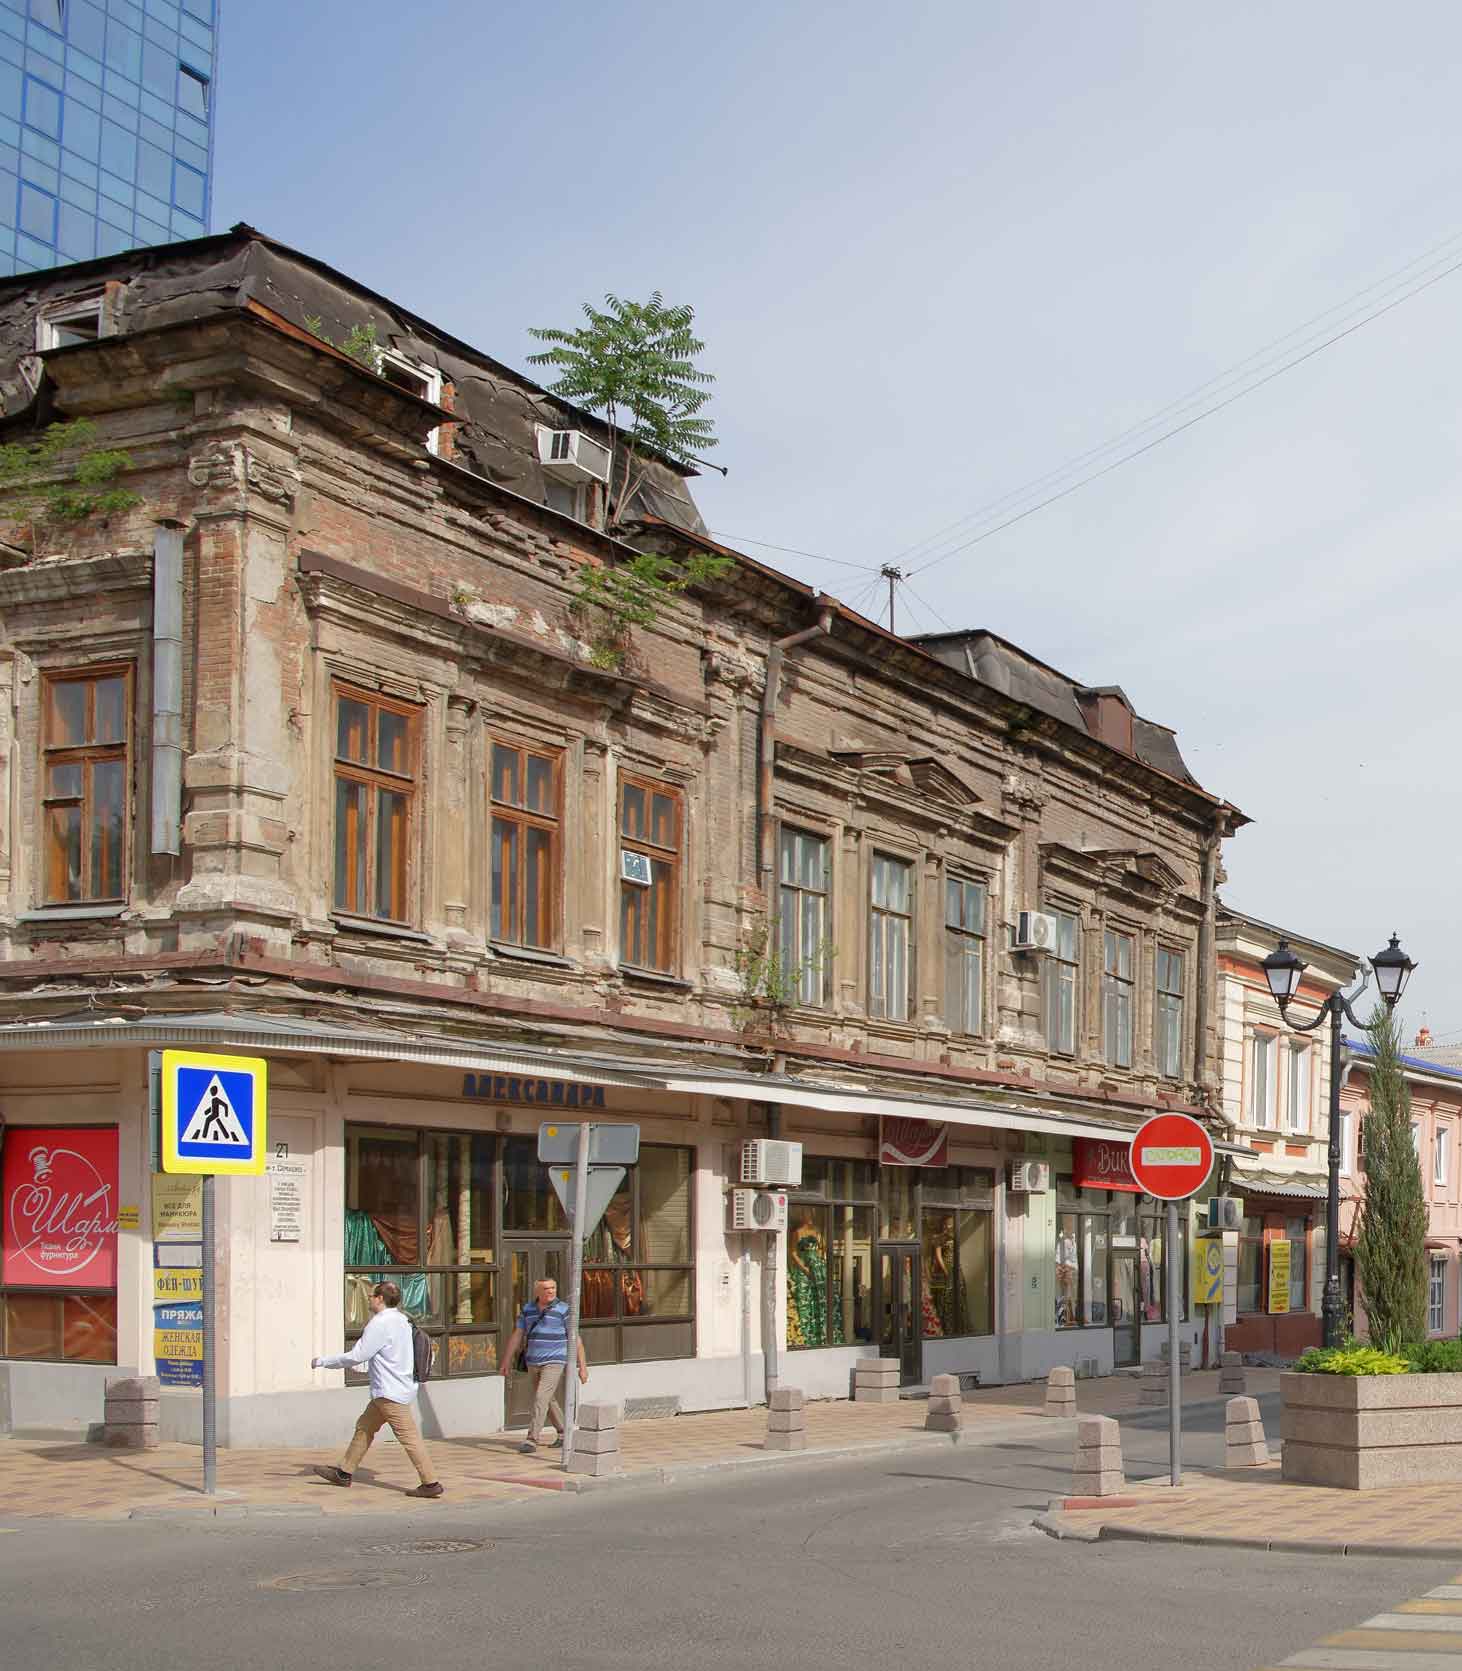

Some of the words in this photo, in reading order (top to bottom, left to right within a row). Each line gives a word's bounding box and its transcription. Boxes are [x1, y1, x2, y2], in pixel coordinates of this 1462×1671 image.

[161, 1310, 203, 1320] ПРЯЖА
[162, 1331, 201, 1343] ЖЕНСКАЯ
[164, 1345, 198, 1357] ОДЕЖДА
